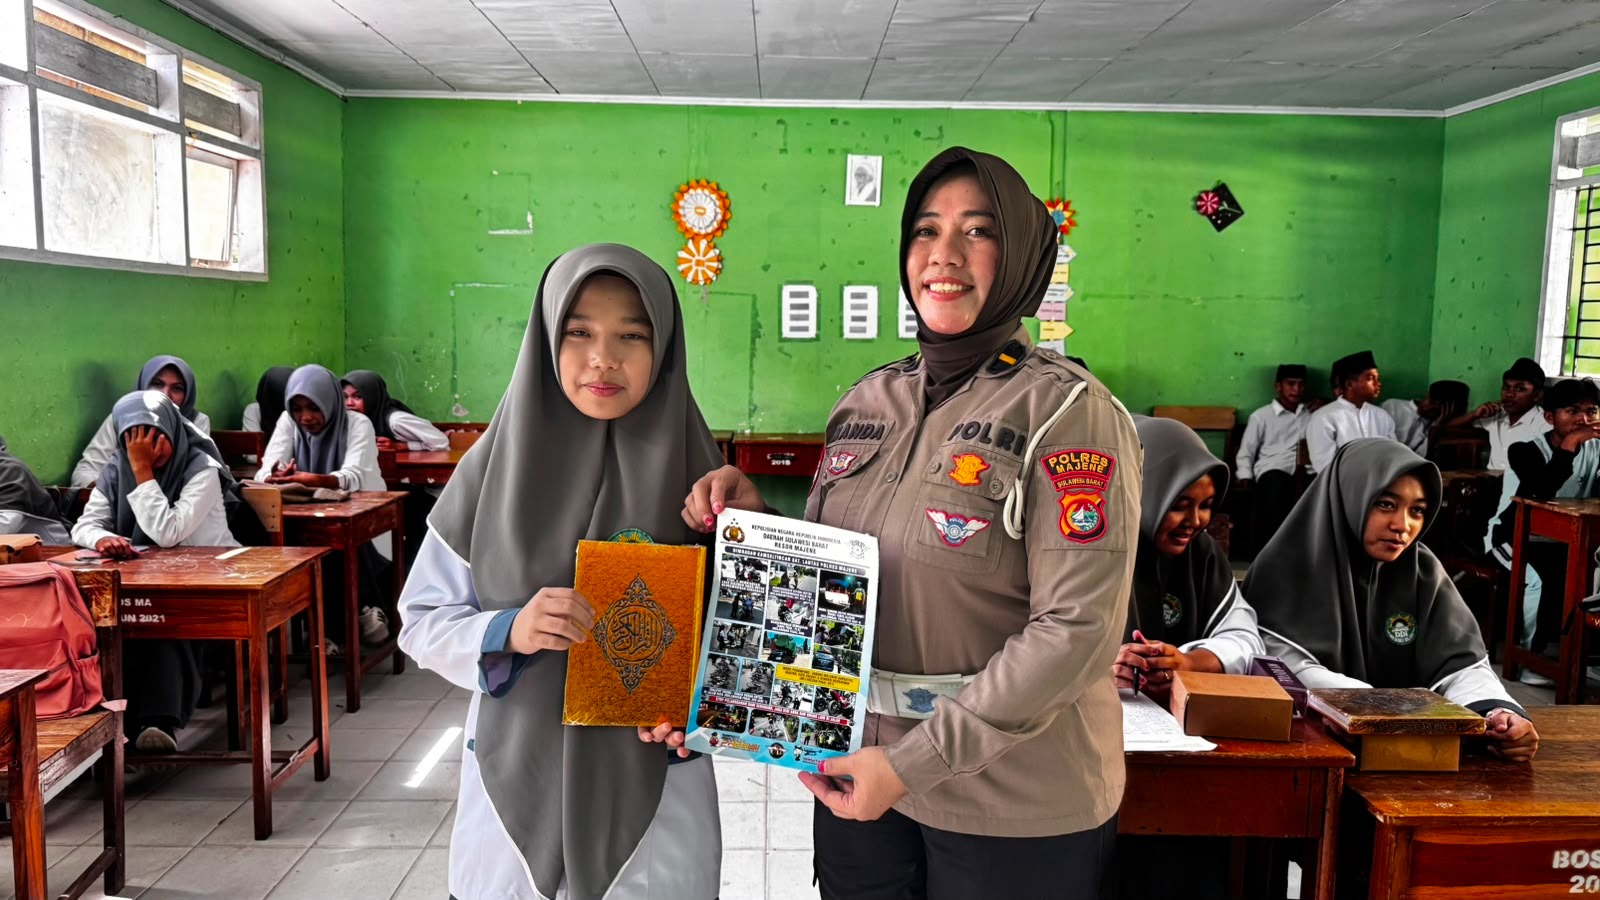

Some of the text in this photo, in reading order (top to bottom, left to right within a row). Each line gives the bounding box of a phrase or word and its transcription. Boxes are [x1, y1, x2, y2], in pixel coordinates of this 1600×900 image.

[1048, 452, 1108, 468] POLRES
[1056, 462, 1105, 474] MAJENE
[1086, 477, 1104, 487] BARAT
[777, 528, 795, 537] NEGARA
[763, 532, 829, 550] DAERAH SULAWESI BARAT
[774, 541, 817, 555] RESOR MAJENE
[134, 598, 152, 607] MA
[139, 614, 166, 623] 2021
[1552, 849, 1600, 869] BOS
